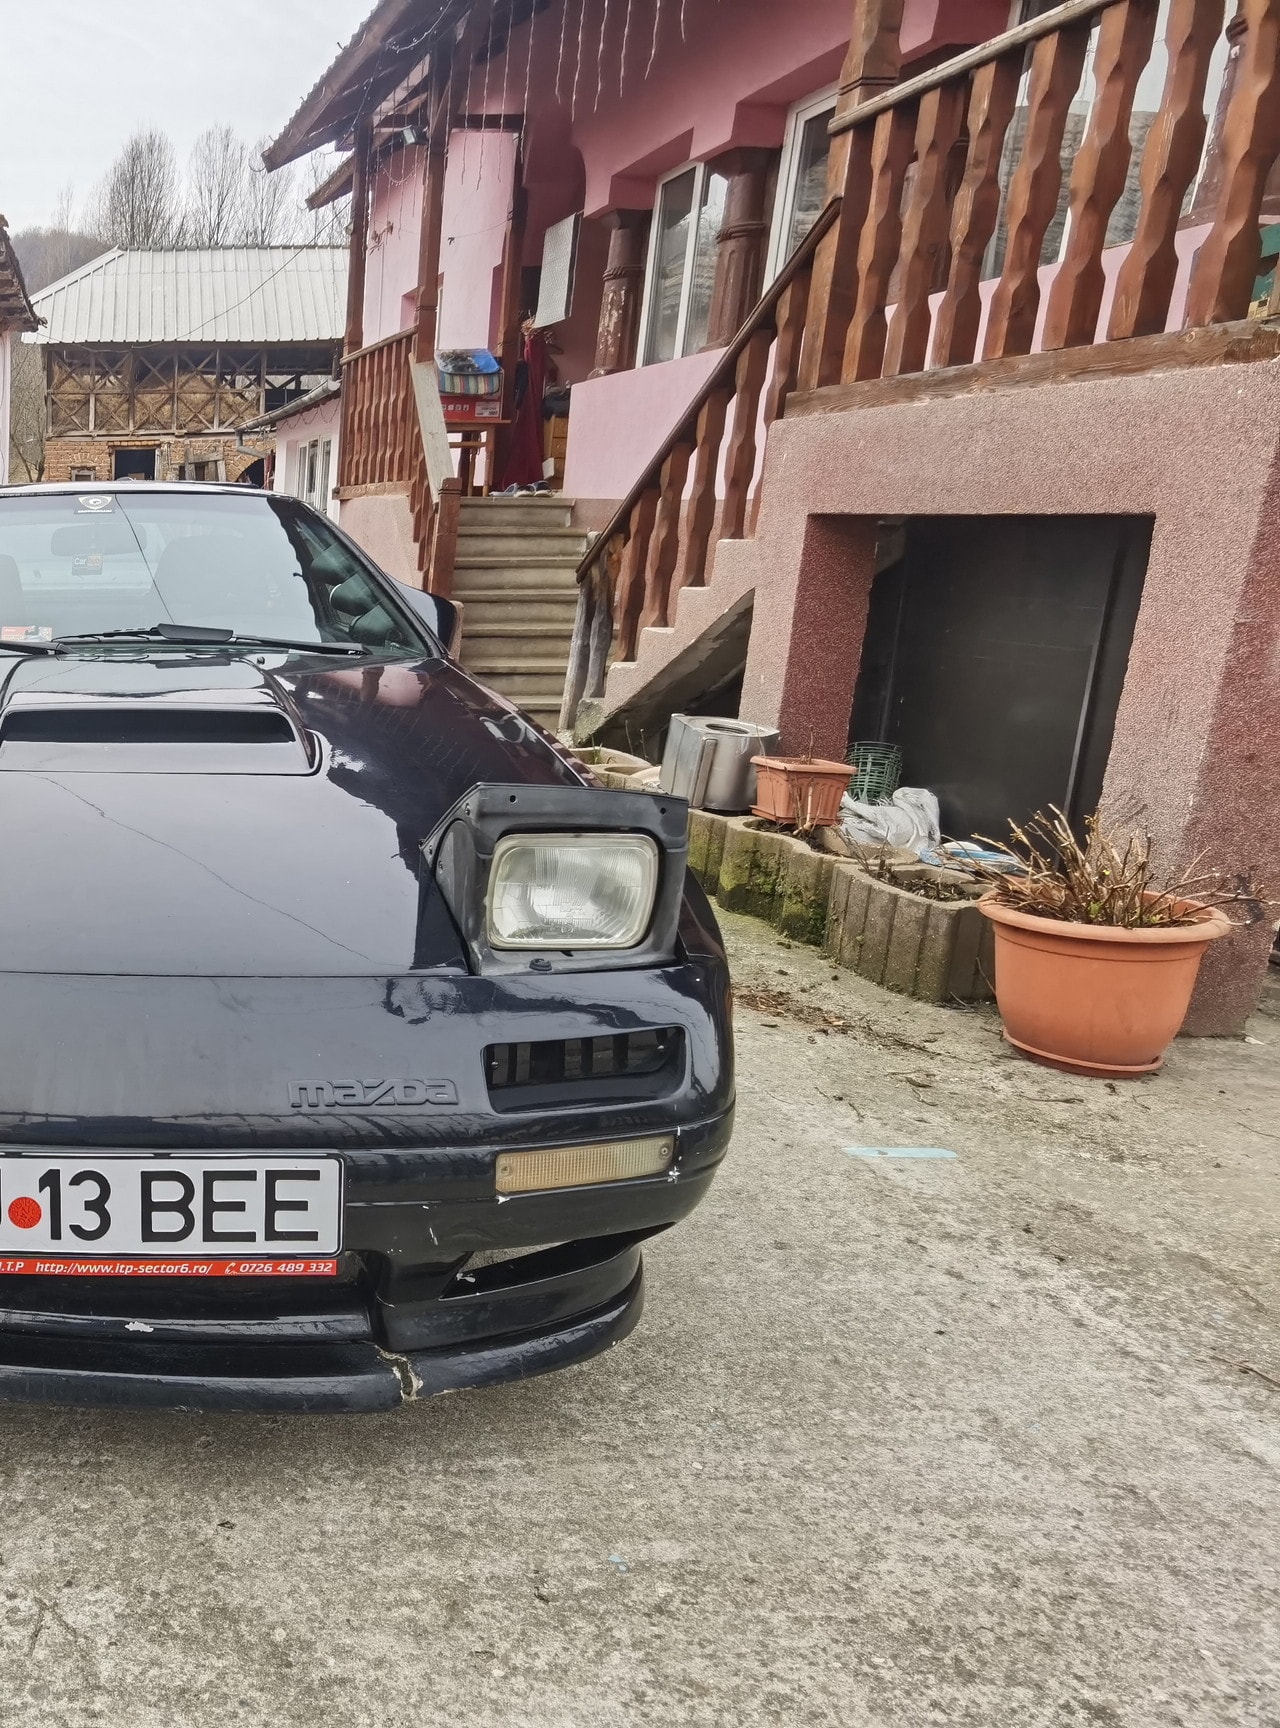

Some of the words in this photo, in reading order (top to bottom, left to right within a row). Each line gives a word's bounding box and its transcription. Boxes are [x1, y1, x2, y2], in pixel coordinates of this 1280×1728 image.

[39, 1169, 111, 1241] 13
[140, 1170, 320, 1242] BEE
[35, 1262, 213, 1275] http://www.itp-sector6.ro/
[239, 1263, 272, 1273] 0726
[277, 1263, 303, 1273] 489
[307, 1263, 333, 1273] 332
